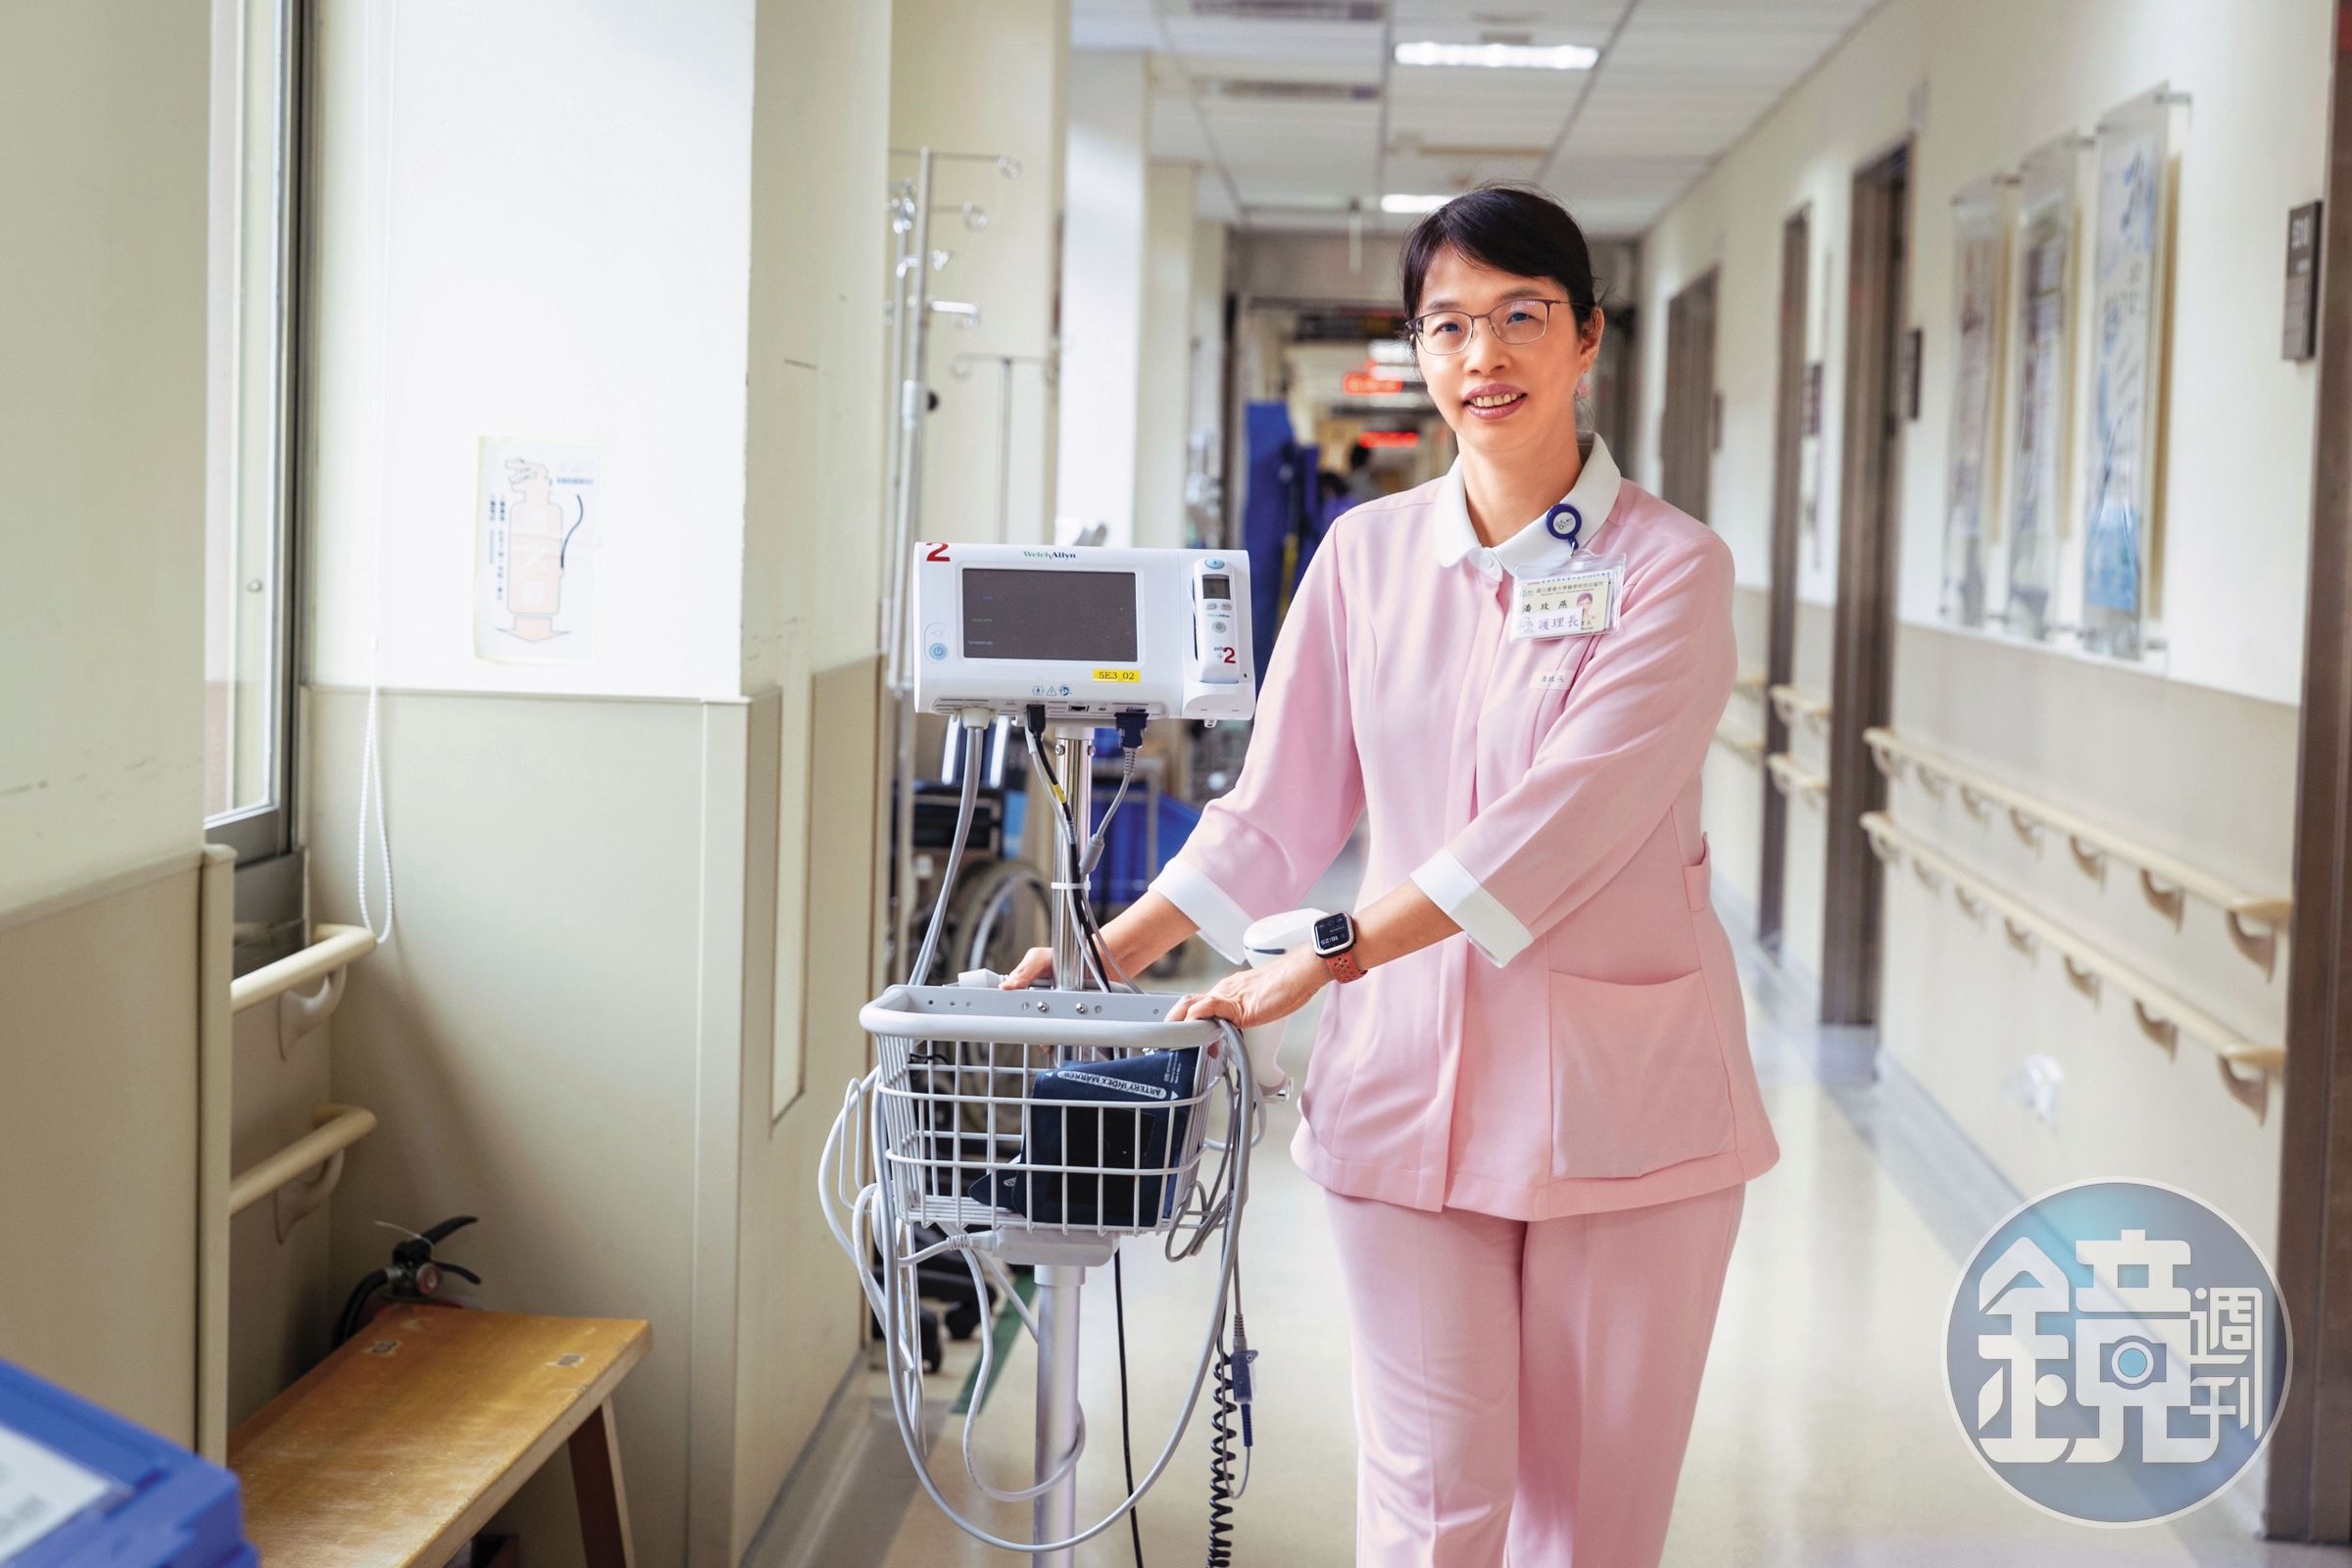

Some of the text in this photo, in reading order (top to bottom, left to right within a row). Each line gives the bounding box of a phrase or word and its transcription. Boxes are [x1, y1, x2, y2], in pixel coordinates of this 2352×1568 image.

[926, 542, 950, 562] 2
[1223, 647, 1236, 663] 2
[1063, 1072, 1161, 1097] ARTERY INDEX MARKER
